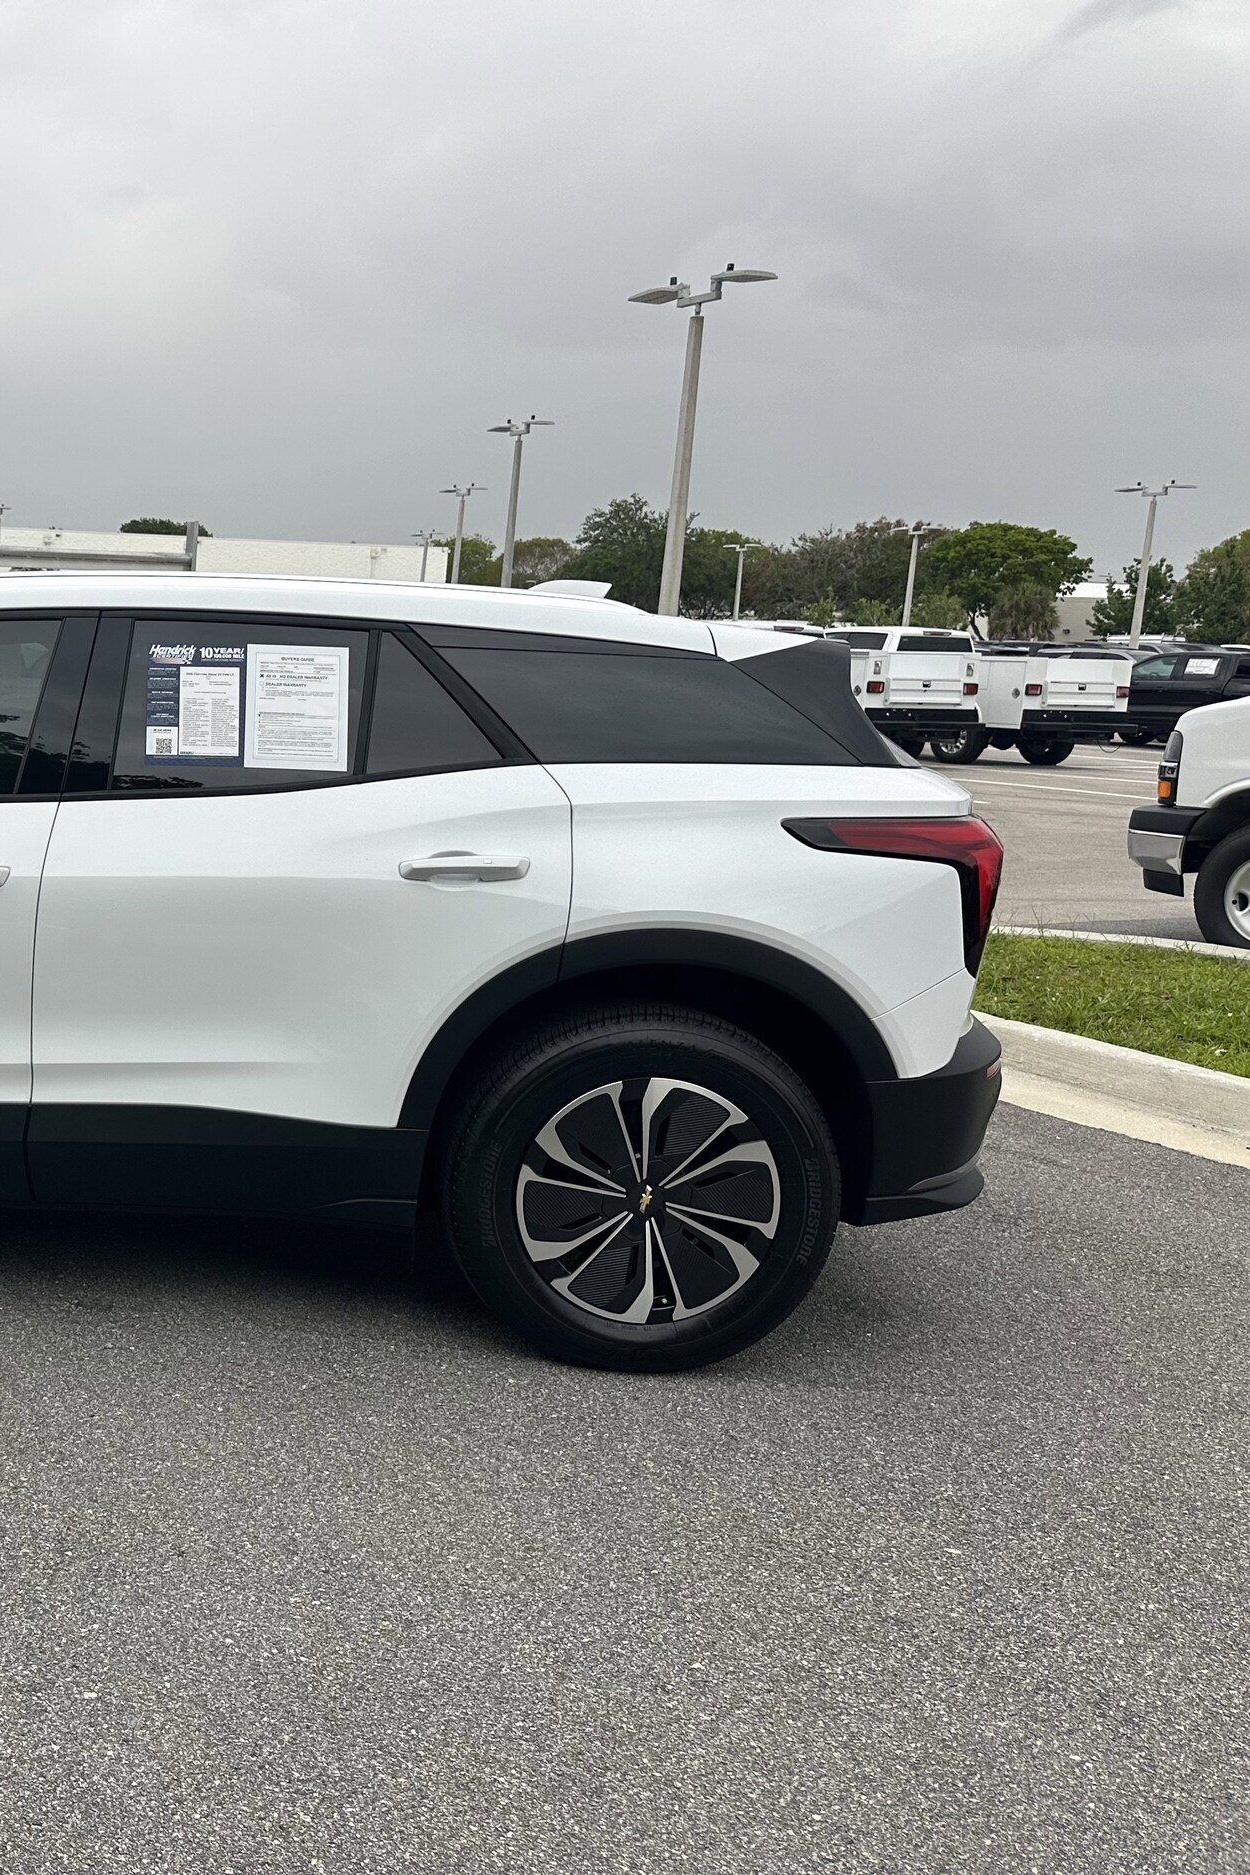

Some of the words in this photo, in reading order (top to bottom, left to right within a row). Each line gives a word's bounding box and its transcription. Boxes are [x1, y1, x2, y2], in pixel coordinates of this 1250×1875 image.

[149, 644, 196, 658] Hendrick
[199, 647, 213, 659] 10
[478, 1140, 503, 1248] BRIDGESTONE
[795, 1158, 822, 1266] BRIDGESTONE
